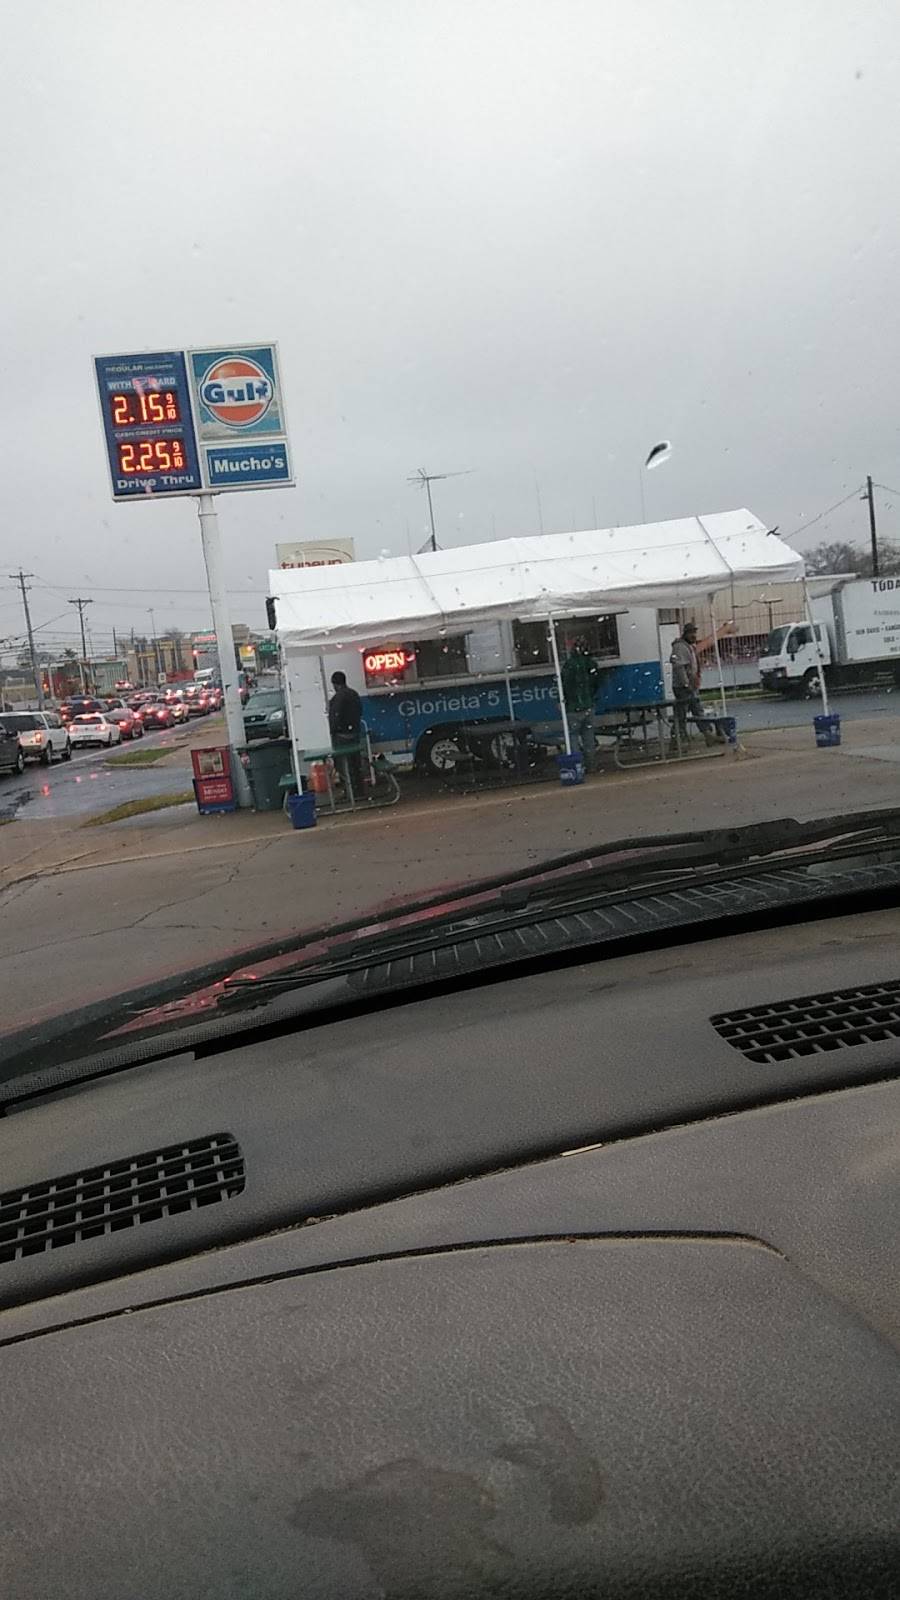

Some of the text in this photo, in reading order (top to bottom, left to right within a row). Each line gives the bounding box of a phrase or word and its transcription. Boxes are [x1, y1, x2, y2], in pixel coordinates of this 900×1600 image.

[203, 381, 269, 403] Gulf
[114, 394, 164, 423] 2.15
[121, 442, 171, 472] 2.25
[214, 456, 285, 473] Mucho's
[117, 474, 194, 489] Drive Thru
[365, 652, 405, 670] OPEN
[398, 694, 480, 717] Glorieta
[487, 689, 500, 706] 5
